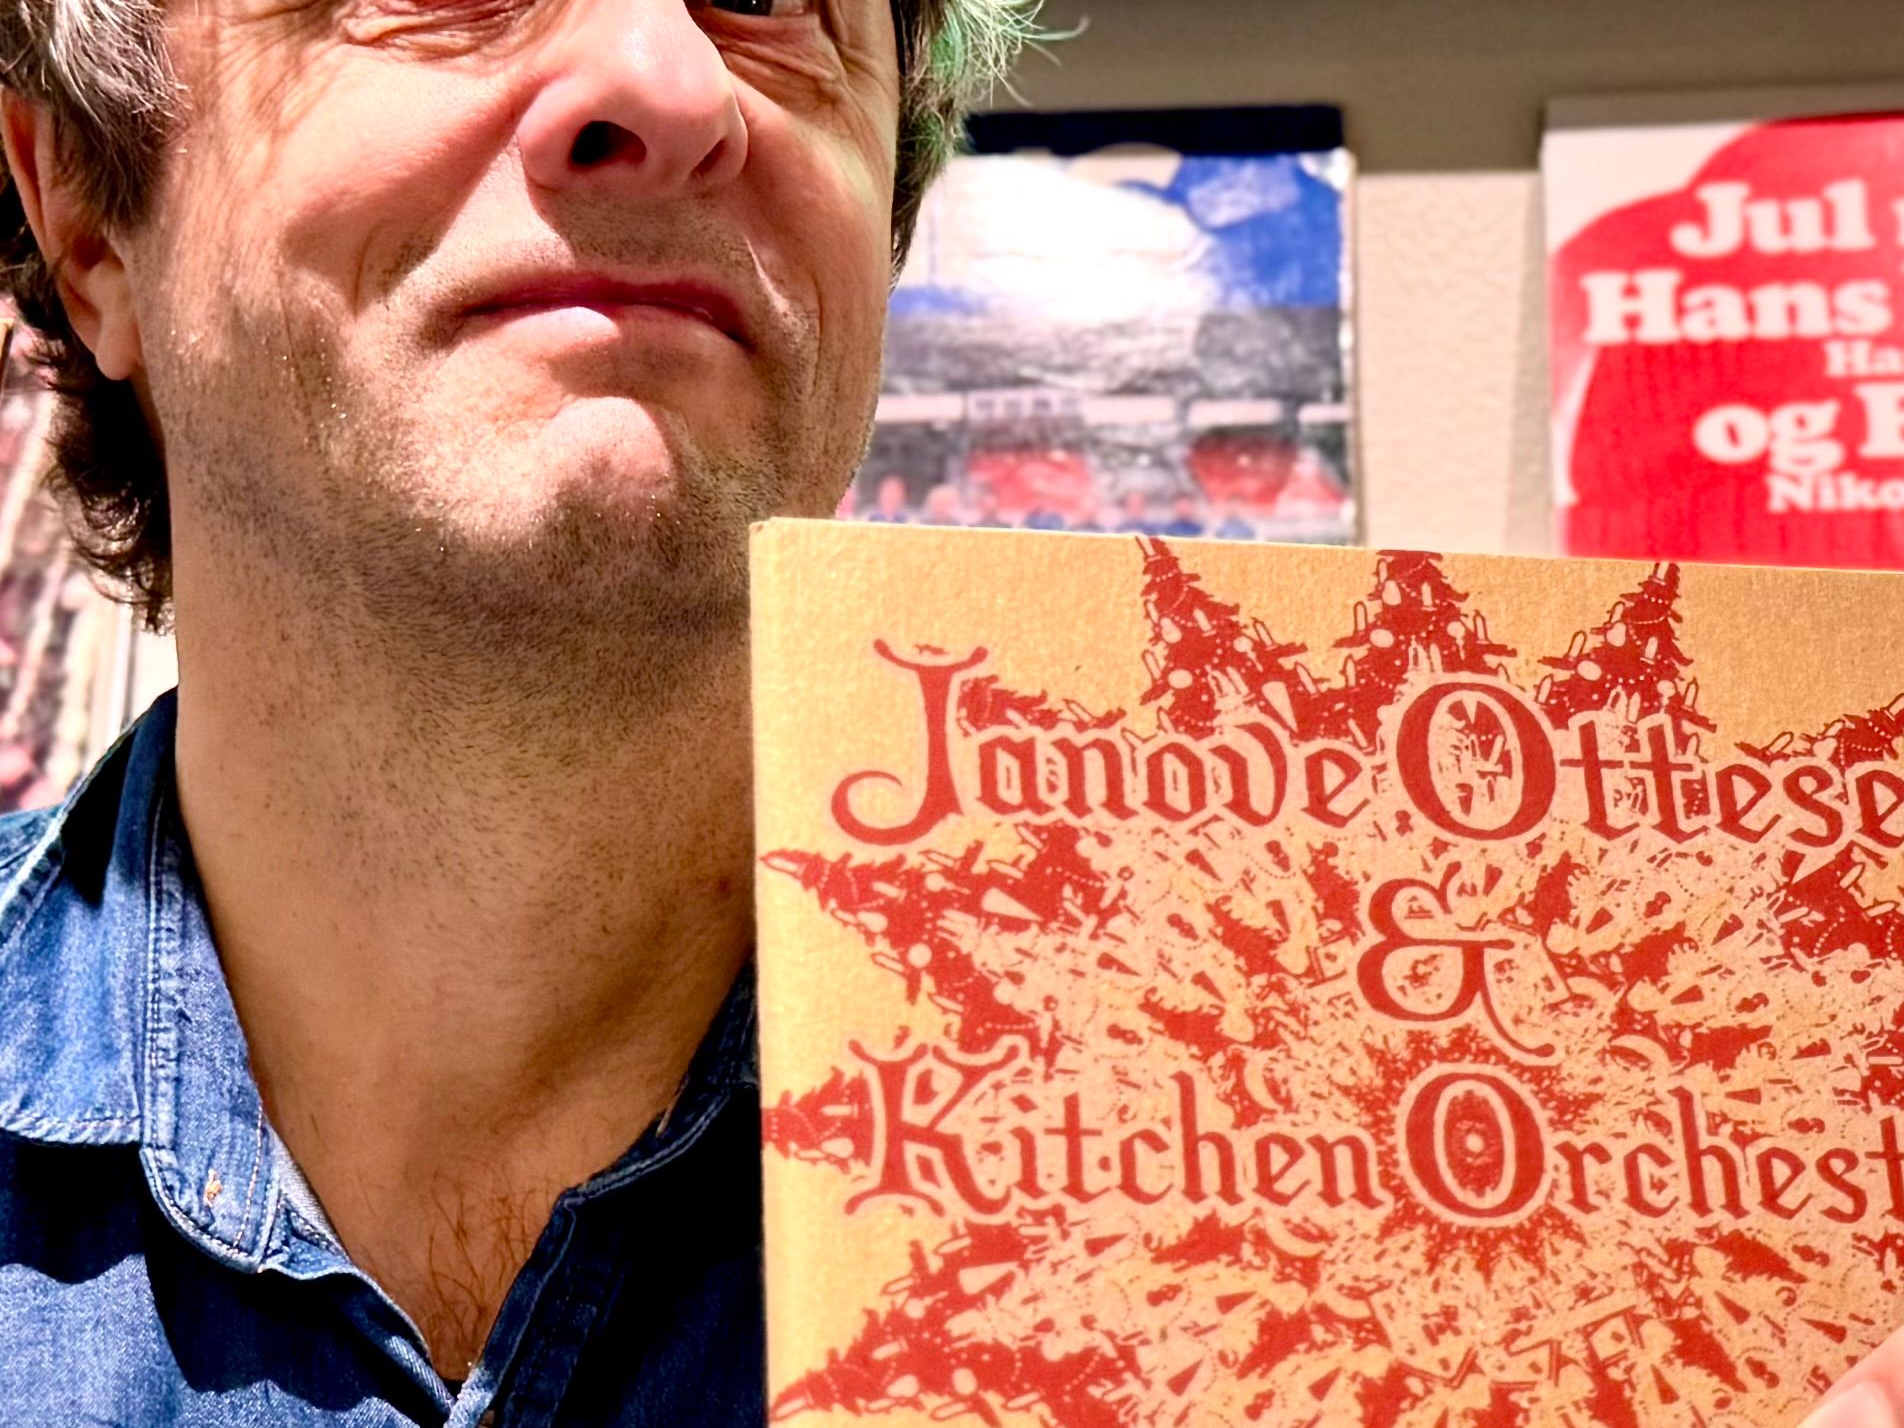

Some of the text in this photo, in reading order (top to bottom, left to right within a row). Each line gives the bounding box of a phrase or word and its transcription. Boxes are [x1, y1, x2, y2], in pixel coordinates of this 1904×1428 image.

[1669, 178, 1876, 259] Jul
[1580, 269, 1892, 344] Hans
[1695, 398, 1845, 474] og
[830, 638, 1371, 847] Janove
[1358, 859, 1556, 1059] &
[844, 1038, 1386, 1215] Kitchen
